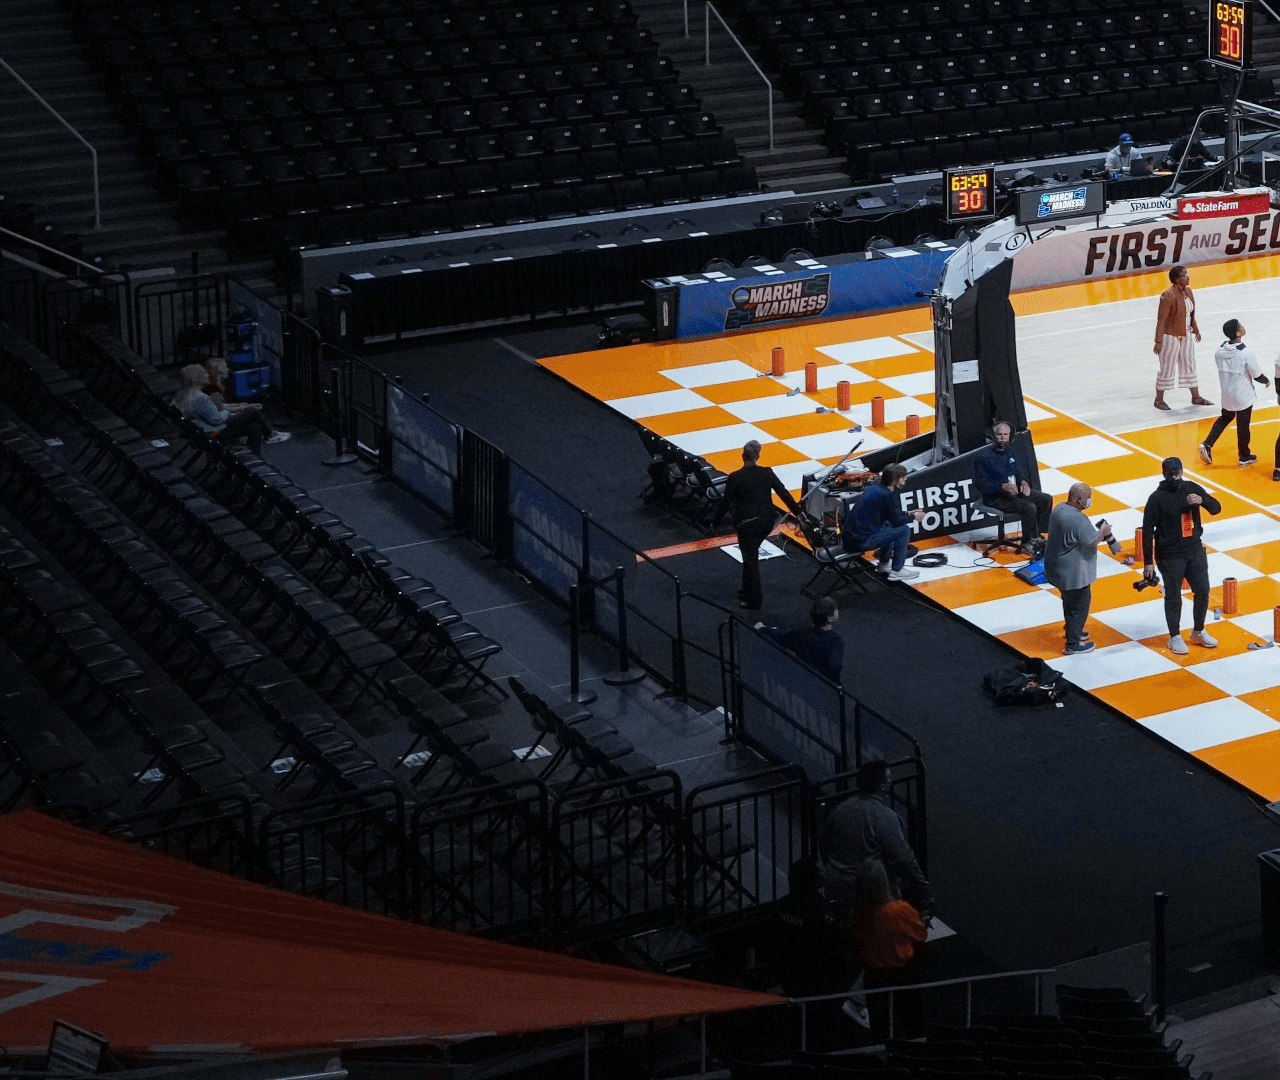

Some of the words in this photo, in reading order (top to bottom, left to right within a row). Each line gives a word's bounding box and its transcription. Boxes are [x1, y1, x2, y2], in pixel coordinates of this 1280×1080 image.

[1216, 2, 1244, 25] 63:59
[1220, 23, 1241, 59] 30
[951, 174, 987, 192] 63:59
[958, 189, 983, 212] 30
[1130, 198, 1172, 213] SPALDING
[1195, 201, 1239, 213] StateFarm
[1084, 223, 1192, 276] FIRST
[1189, 232, 1222, 250] AND
[749, 281, 803, 304] MARCH
[755, 294, 827, 318] MADNESS
[901, 478, 973, 513] FIRST
[906, 501, 998, 535] ORIZ
